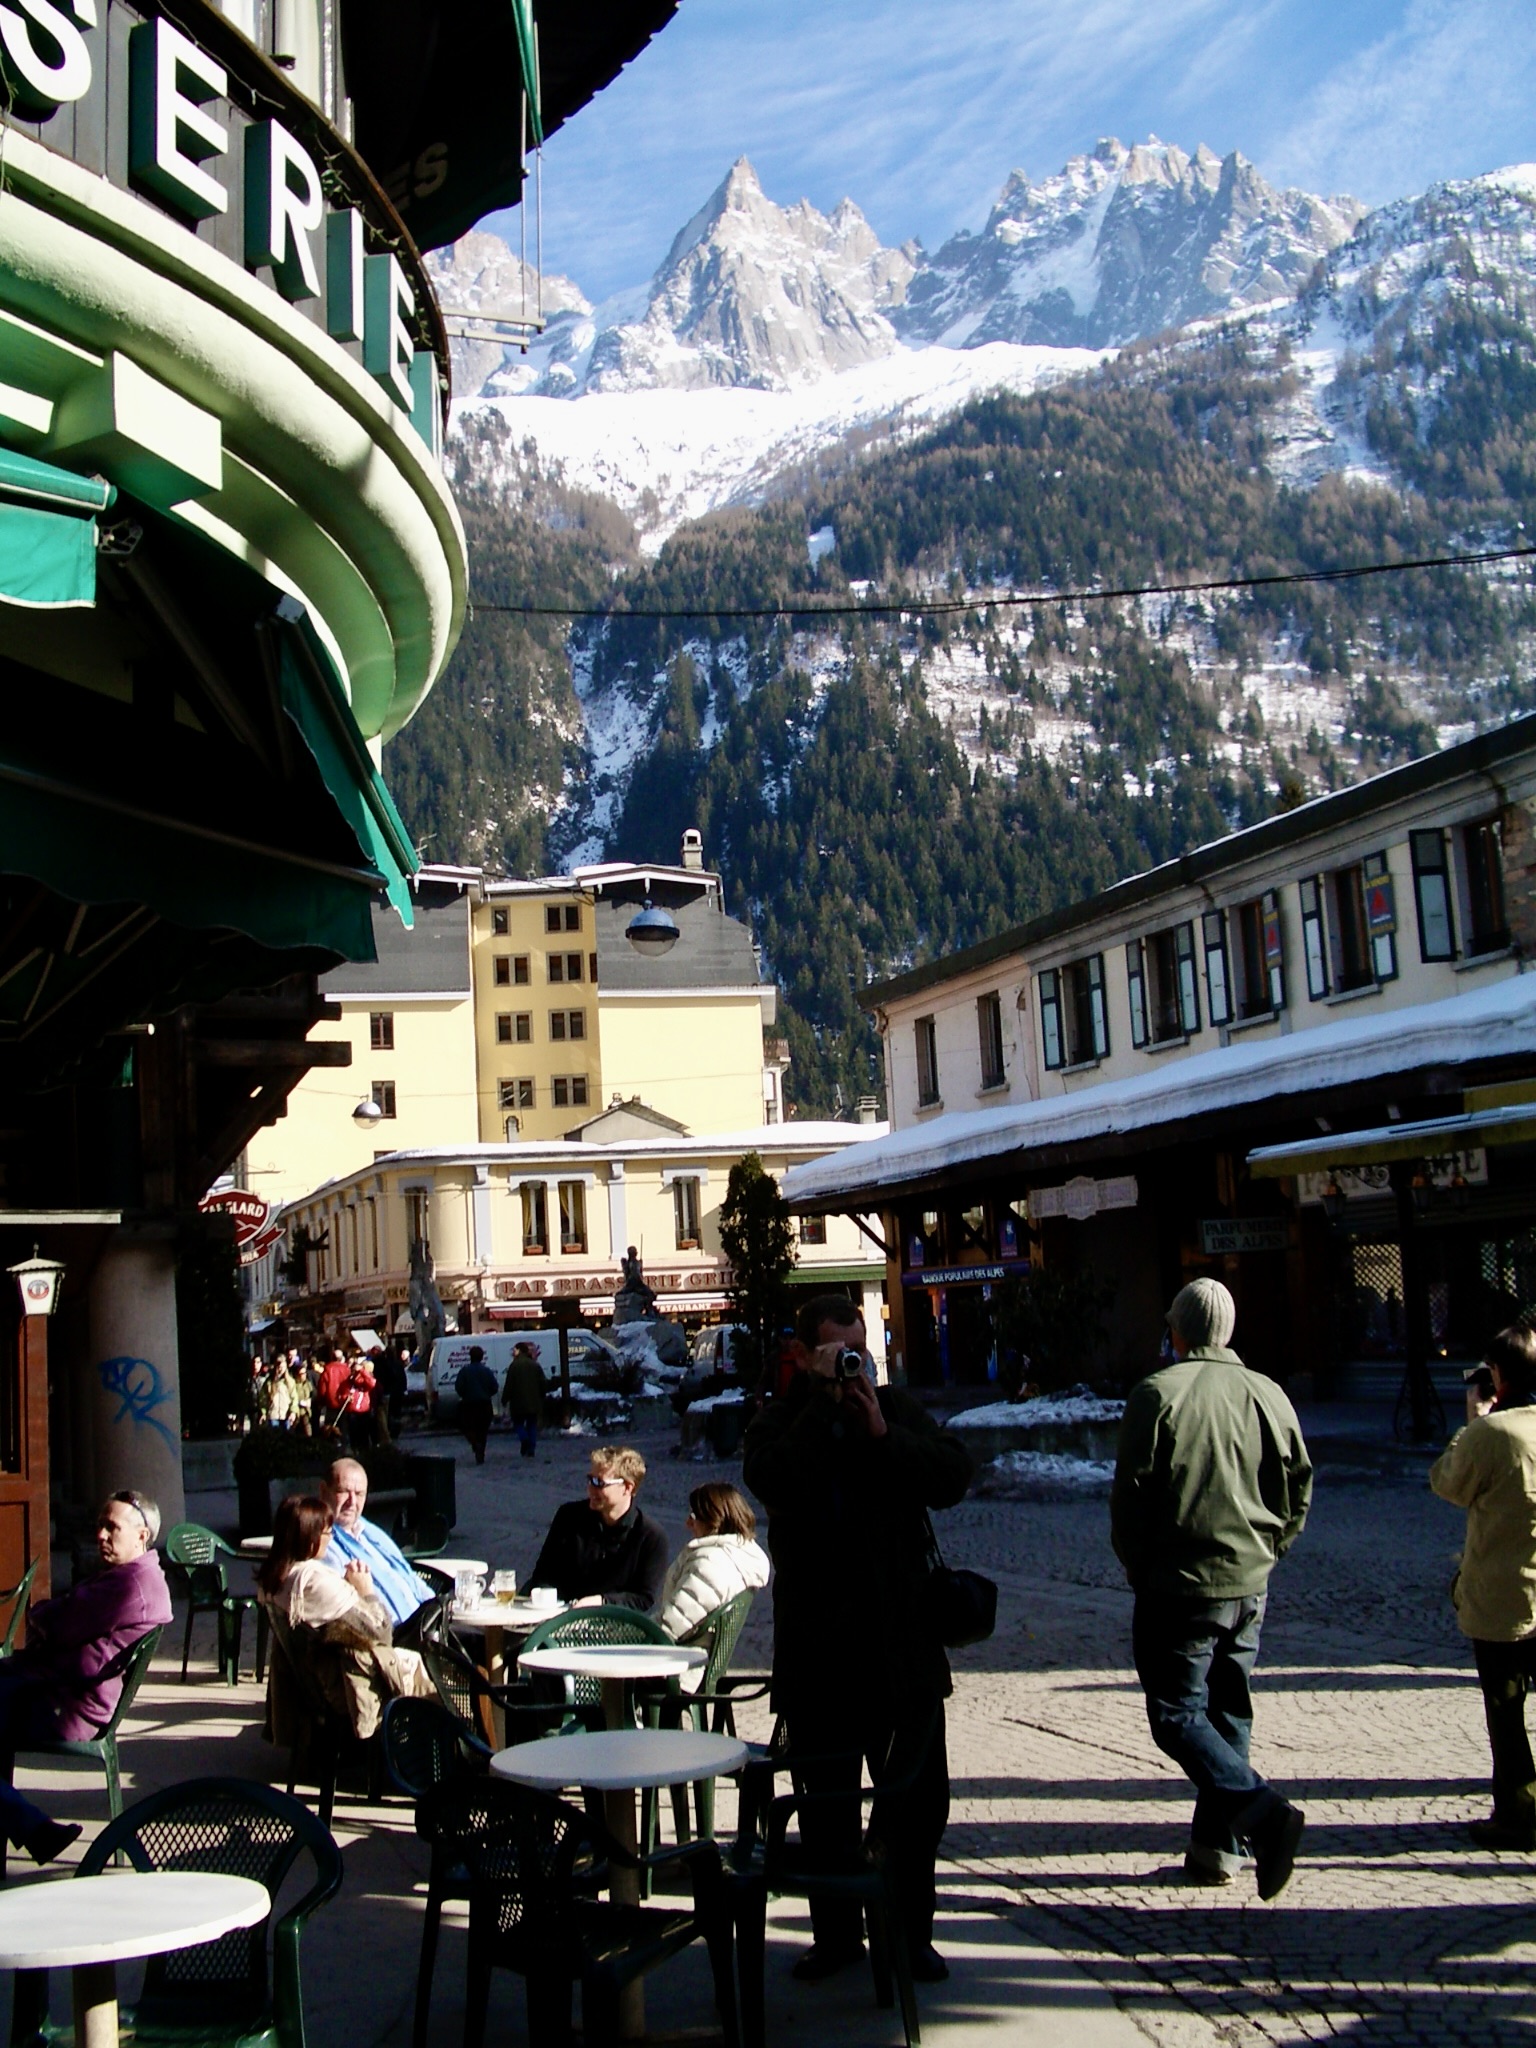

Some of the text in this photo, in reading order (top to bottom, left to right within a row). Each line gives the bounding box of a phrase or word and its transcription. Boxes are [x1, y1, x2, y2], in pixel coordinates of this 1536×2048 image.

[1205, 1220, 1284, 1236] PARFUMERIE
[1211, 1234, 1283, 1250] DES ALPES
[503, 1279, 549, 1294] BAR
[558, 1273, 682, 1292] BRASSRIE
[921, 1267, 1005, 1285] BANQUE POPULAIRE DES ALPES
[656, 1302, 712, 1314] STAURANT
